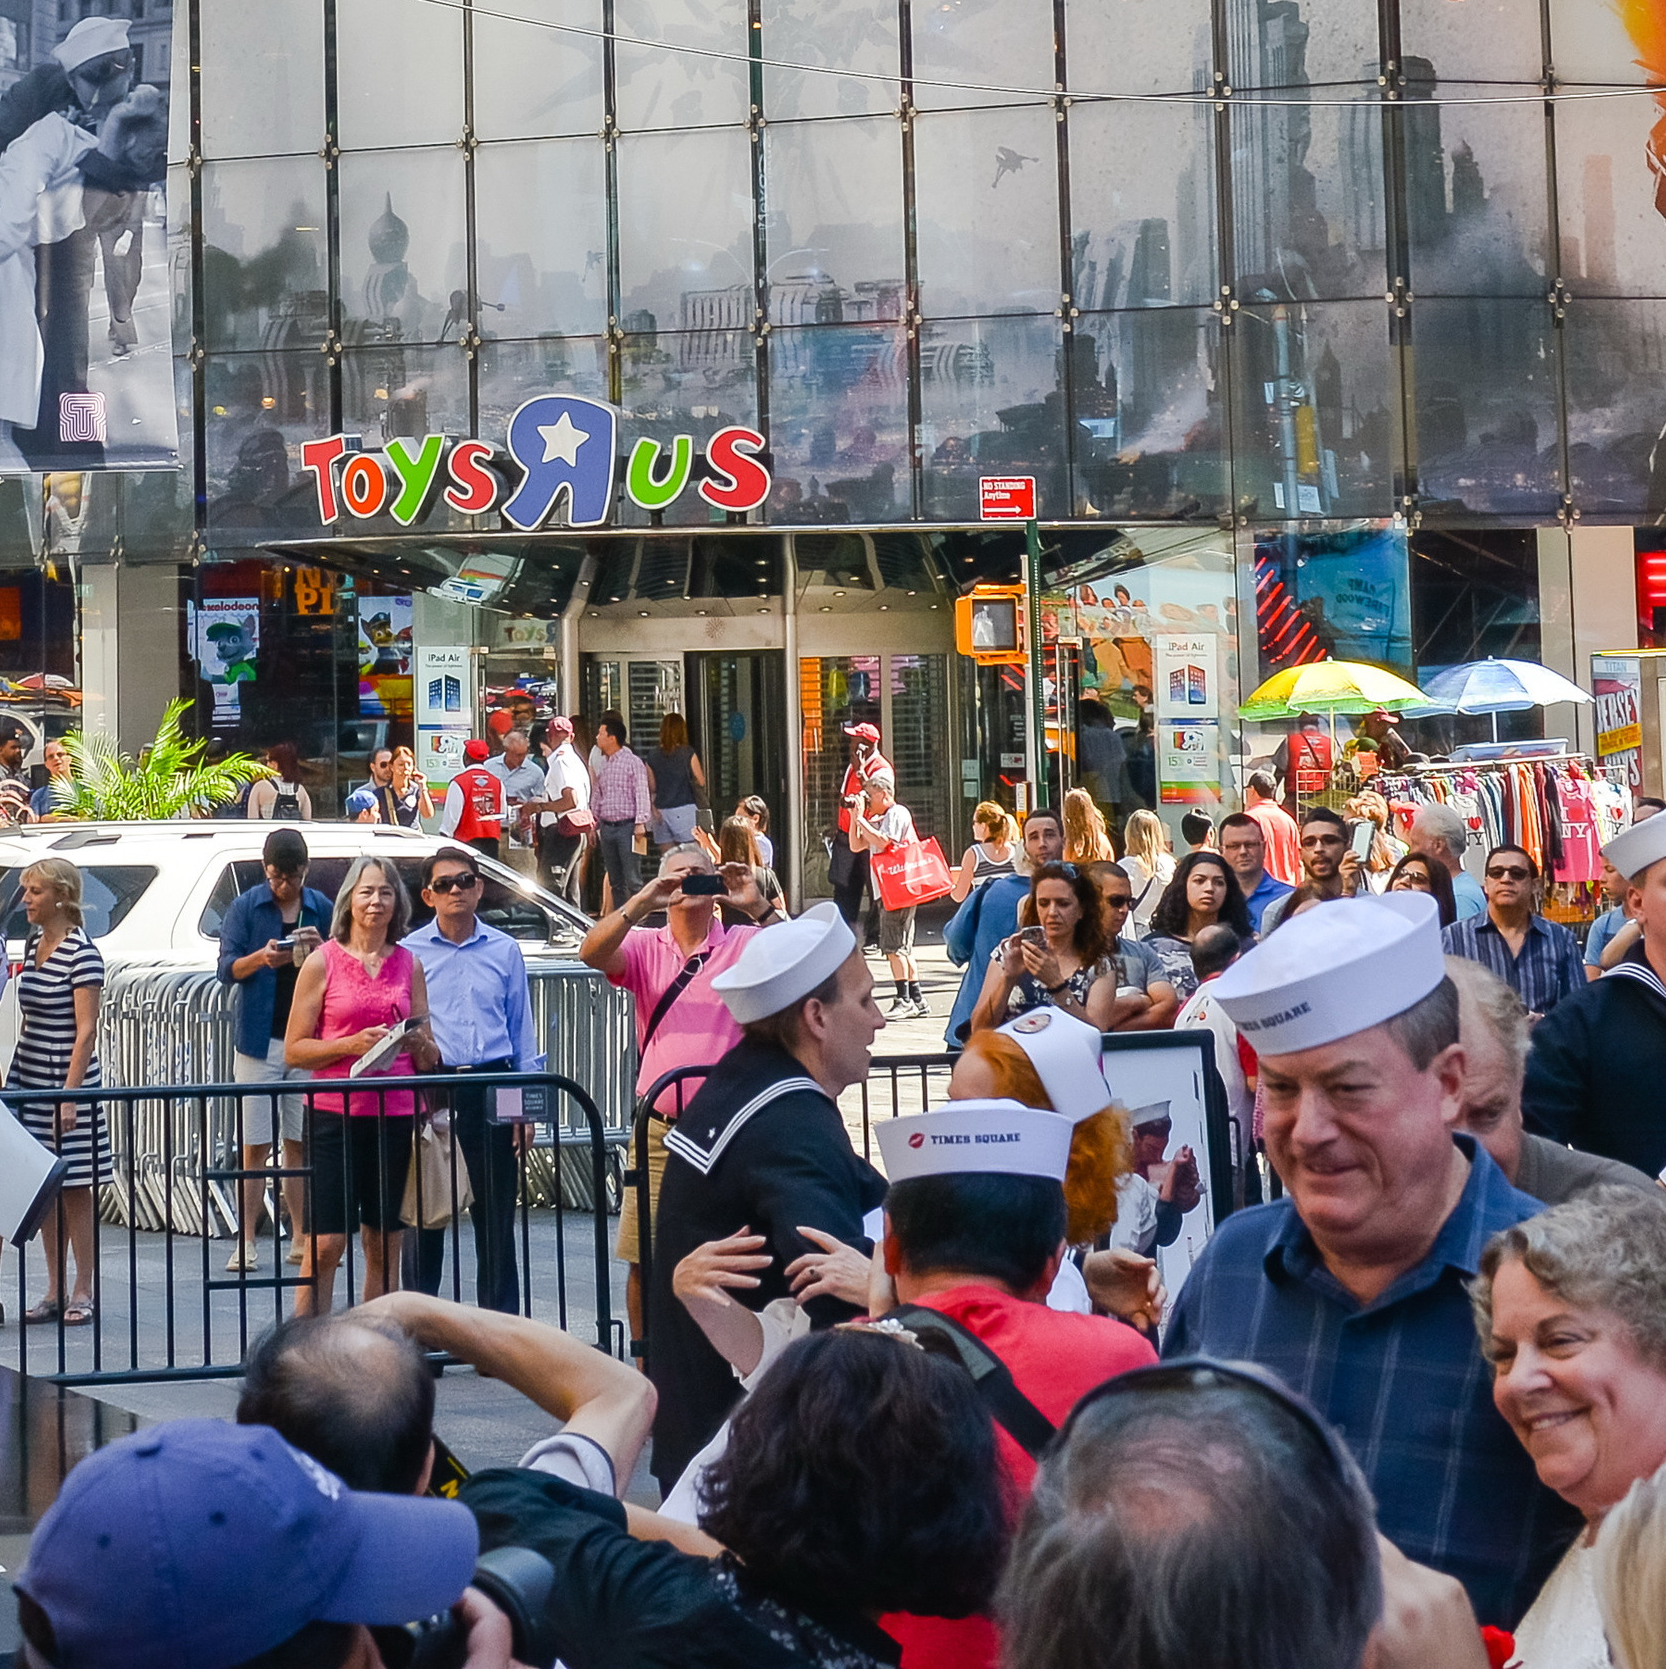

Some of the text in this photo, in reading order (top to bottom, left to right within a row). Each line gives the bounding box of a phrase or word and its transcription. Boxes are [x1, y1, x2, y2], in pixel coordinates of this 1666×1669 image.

[994, 481, 1026, 490] STANDING
[984, 491, 1011, 501] Anytime
[1169, 642, 1205, 651] iPad Air
[428, 653, 460, 662] iPad Air
[1605, 661, 1627, 672] TITAN
[1261, 1001, 1312, 1030] SQUARE
[931, 1132, 1021, 1145] TIMES SQUARE
